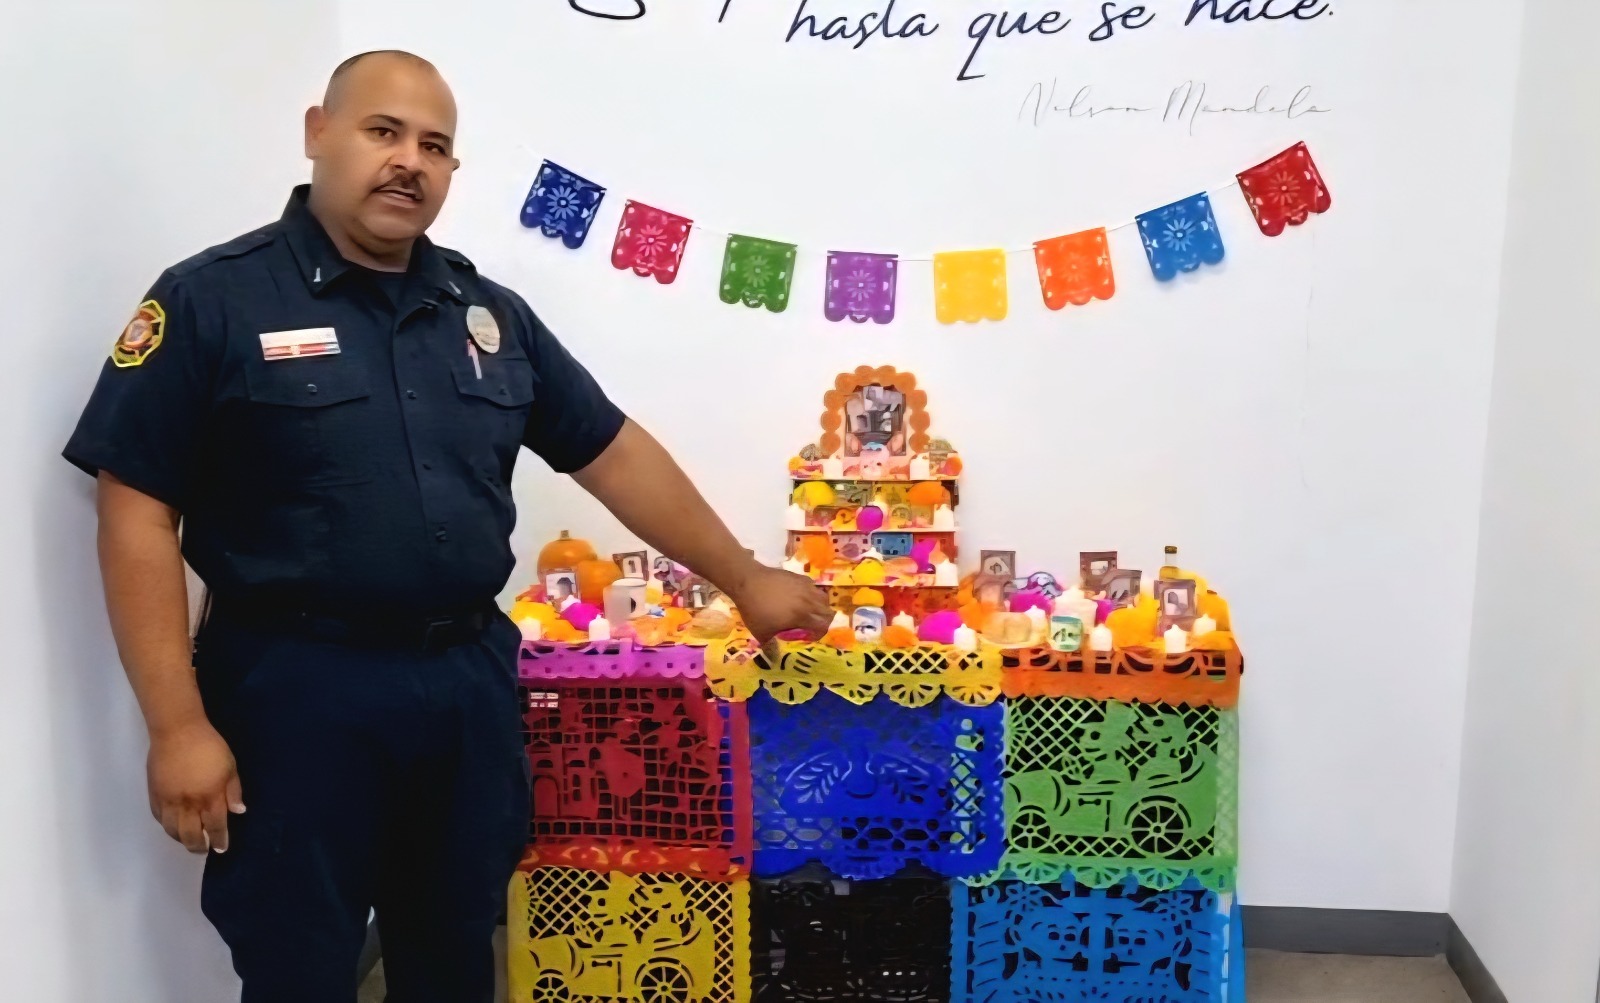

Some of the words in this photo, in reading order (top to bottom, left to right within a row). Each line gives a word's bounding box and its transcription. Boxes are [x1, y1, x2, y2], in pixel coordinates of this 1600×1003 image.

[956, 10, 1071, 81] que
[1088, 1, 1156, 41] se
[1163, 80, 1331, 136] Mandela
